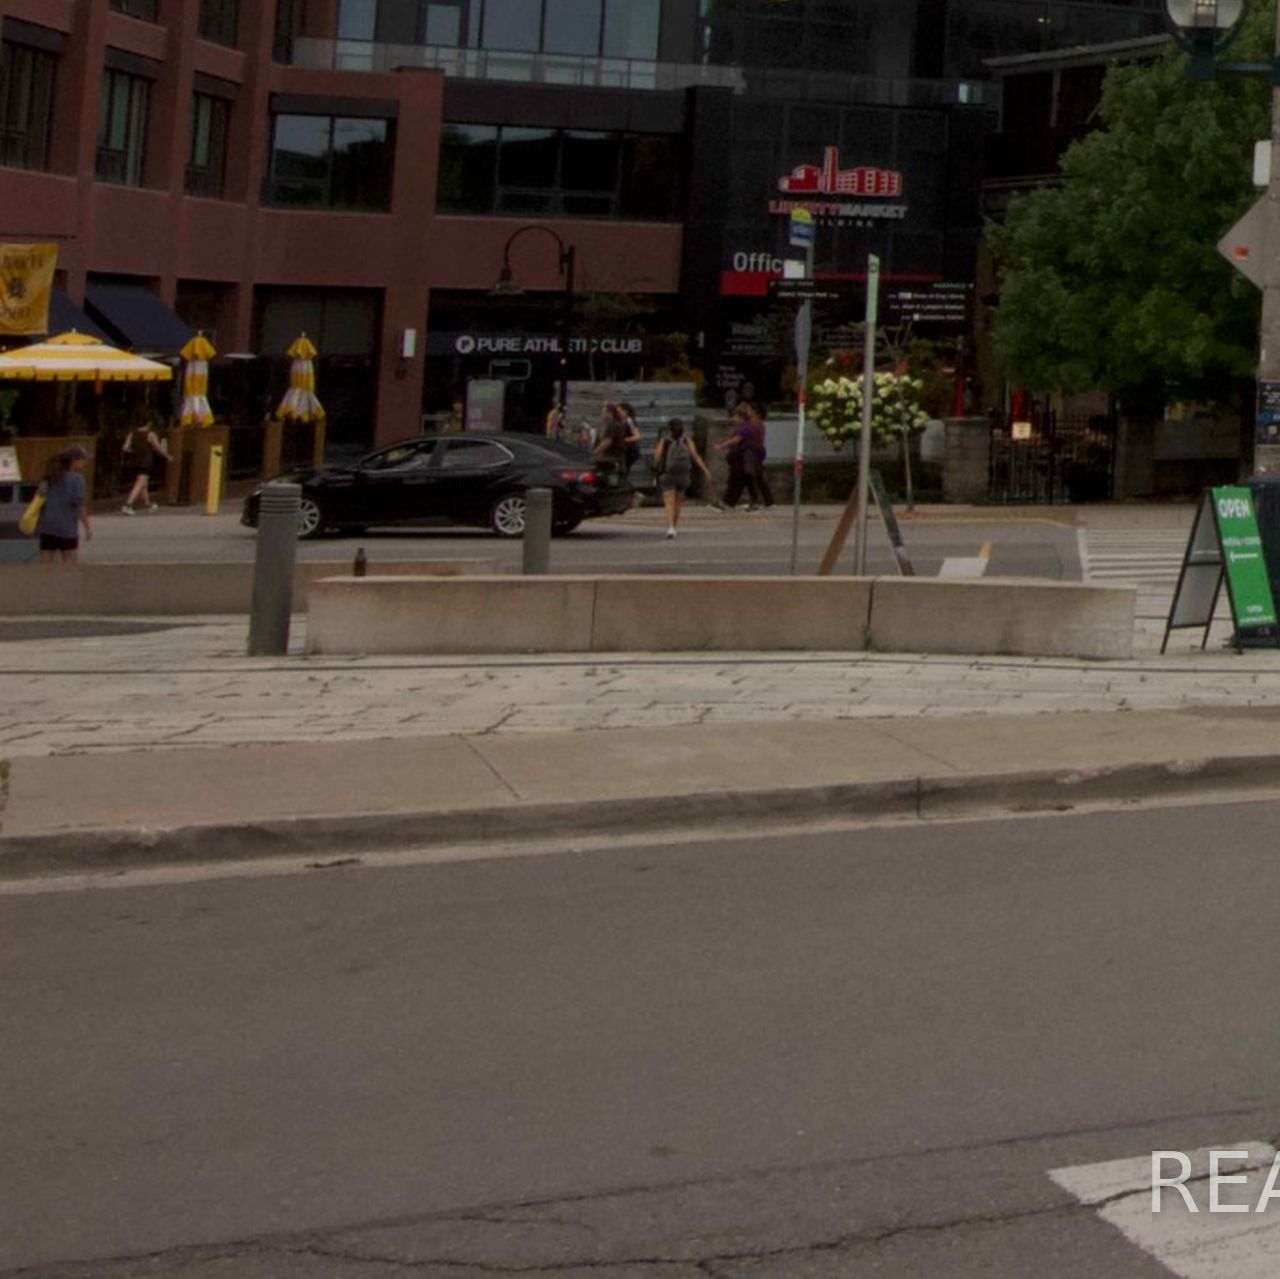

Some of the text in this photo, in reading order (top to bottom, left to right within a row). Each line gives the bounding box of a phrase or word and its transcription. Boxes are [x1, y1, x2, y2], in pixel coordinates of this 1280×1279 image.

[477, 337, 523, 352] PURE
[600, 338, 642, 353] CLUB
[1218, 498, 1251, 518] OPEN
